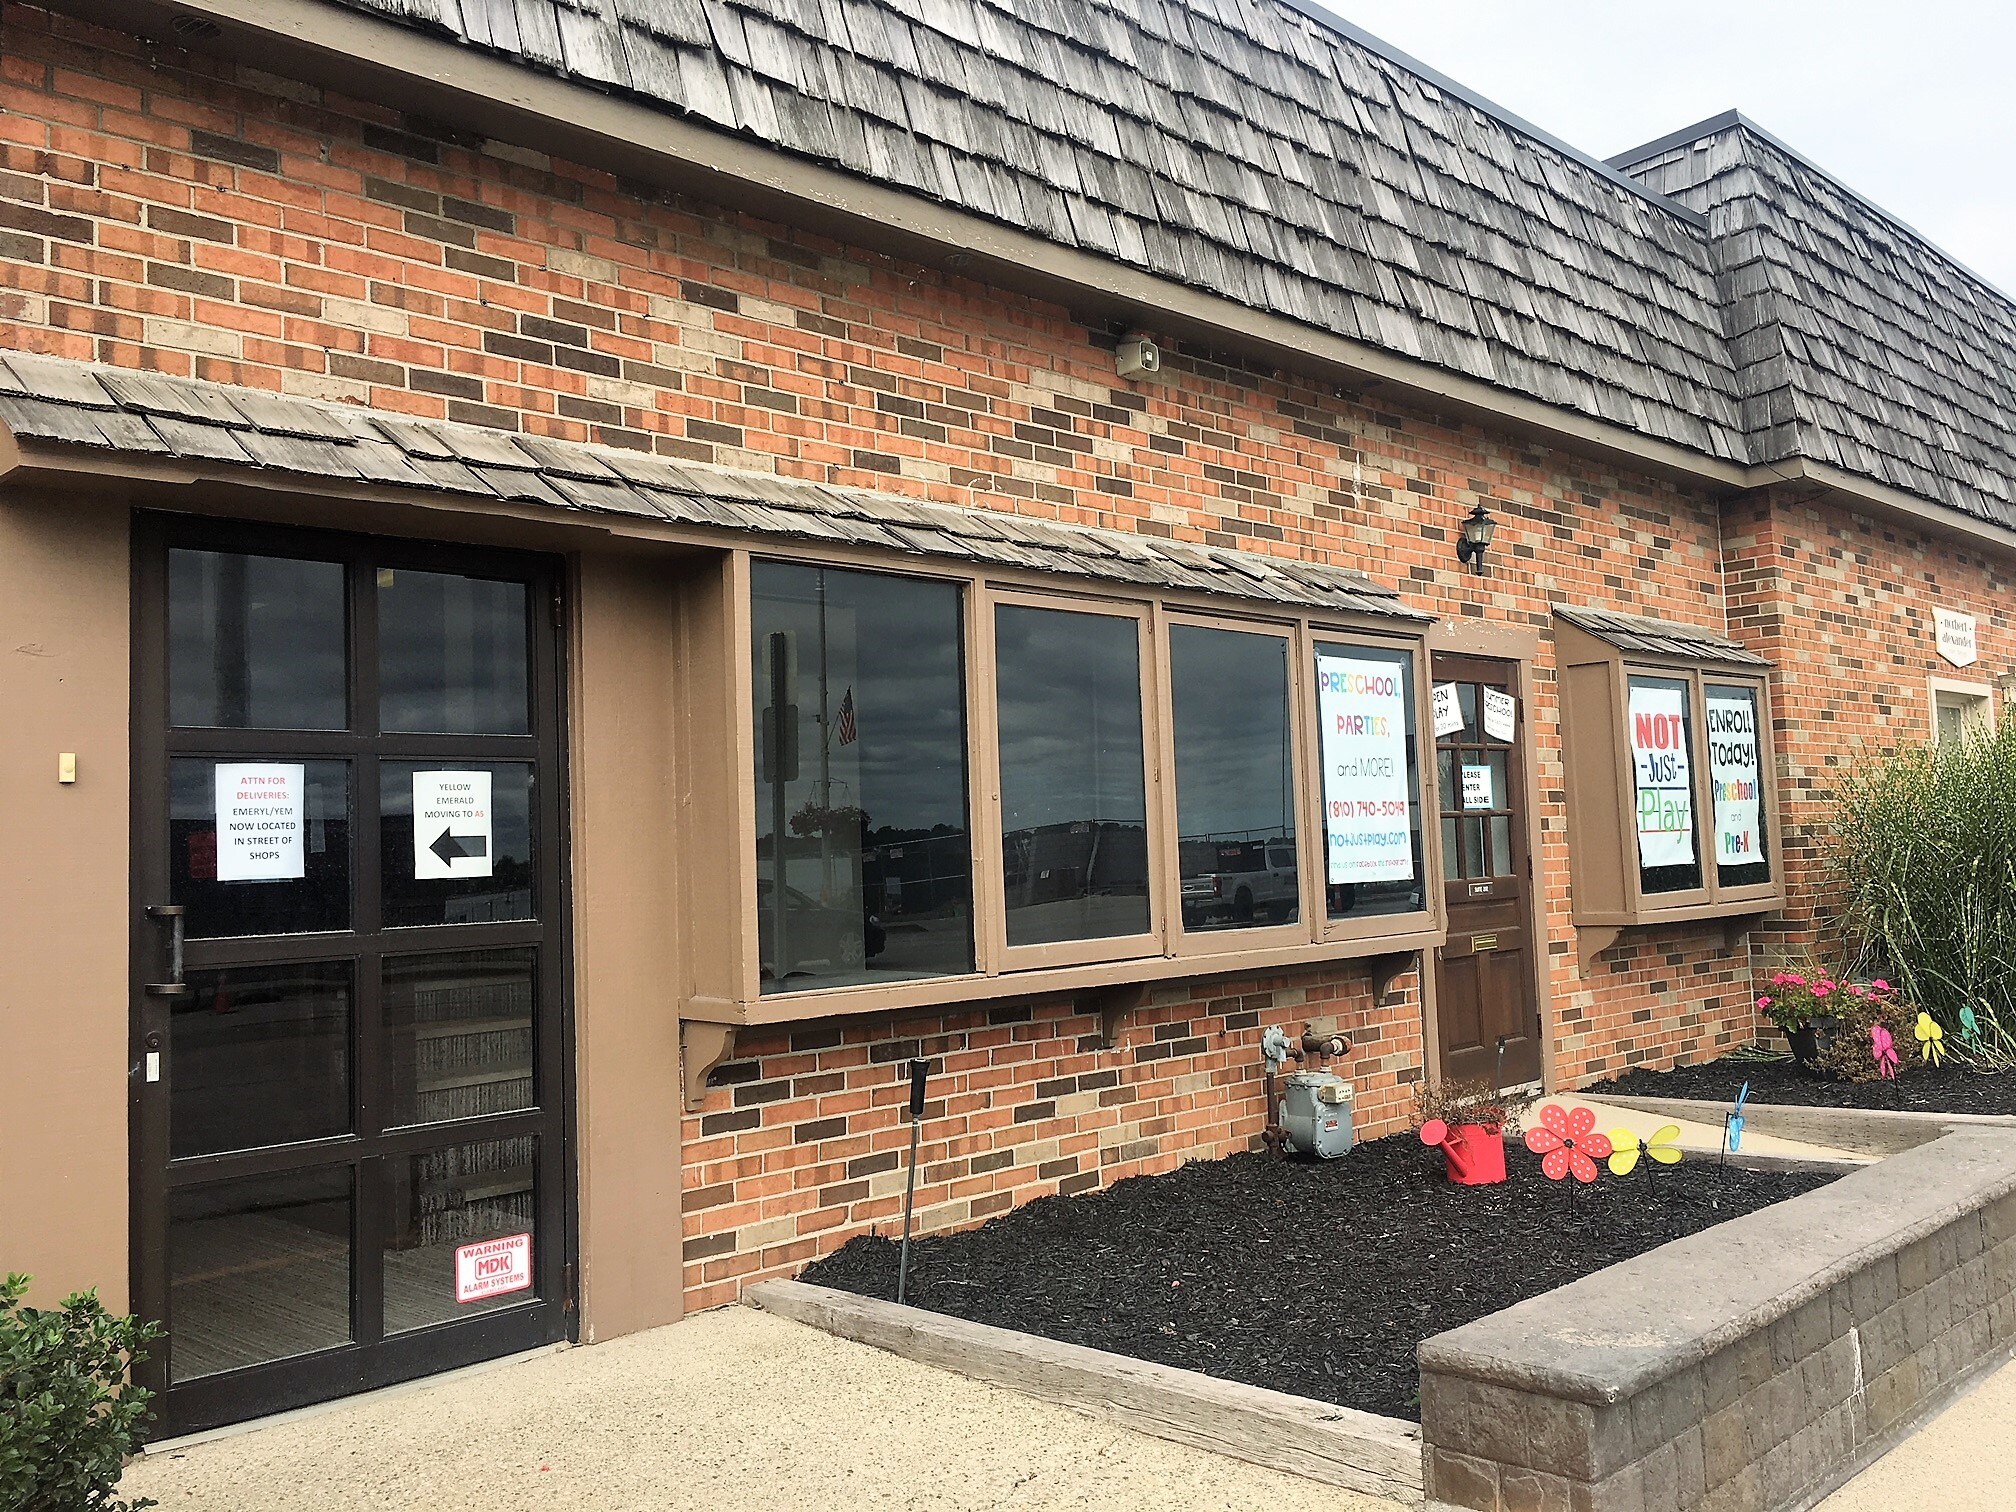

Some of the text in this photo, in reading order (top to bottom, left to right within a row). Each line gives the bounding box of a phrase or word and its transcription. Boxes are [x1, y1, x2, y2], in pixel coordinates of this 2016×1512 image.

[1433, 705, 1448, 719] LAY
[1708, 709, 1752, 734] ENROLL
[1337, 714, 1390, 738] PARTIES,
[1635, 712, 1680, 750] NOT
[1711, 742, 1755, 767] Today!
[1337, 757, 1394, 777] and MORE!
[1715, 779, 1757, 802] Preschool
[233, 807, 293, 816] EMERYL/YEM
[1329, 800, 1405, 818] (810) 740-5049
[1641, 788, 1686, 844] Play
[1731, 809, 1742, 822] and
[1724, 831, 1749, 854] Pre-K
[250, 851, 280, 860] SHOPS
[463, 1238, 523, 1258] WARNING
[478, 1256, 510, 1275] MDK
[464, 1281, 488, 1293] ALARM
[491, 1273, 524, 1287] SYSTEMS
